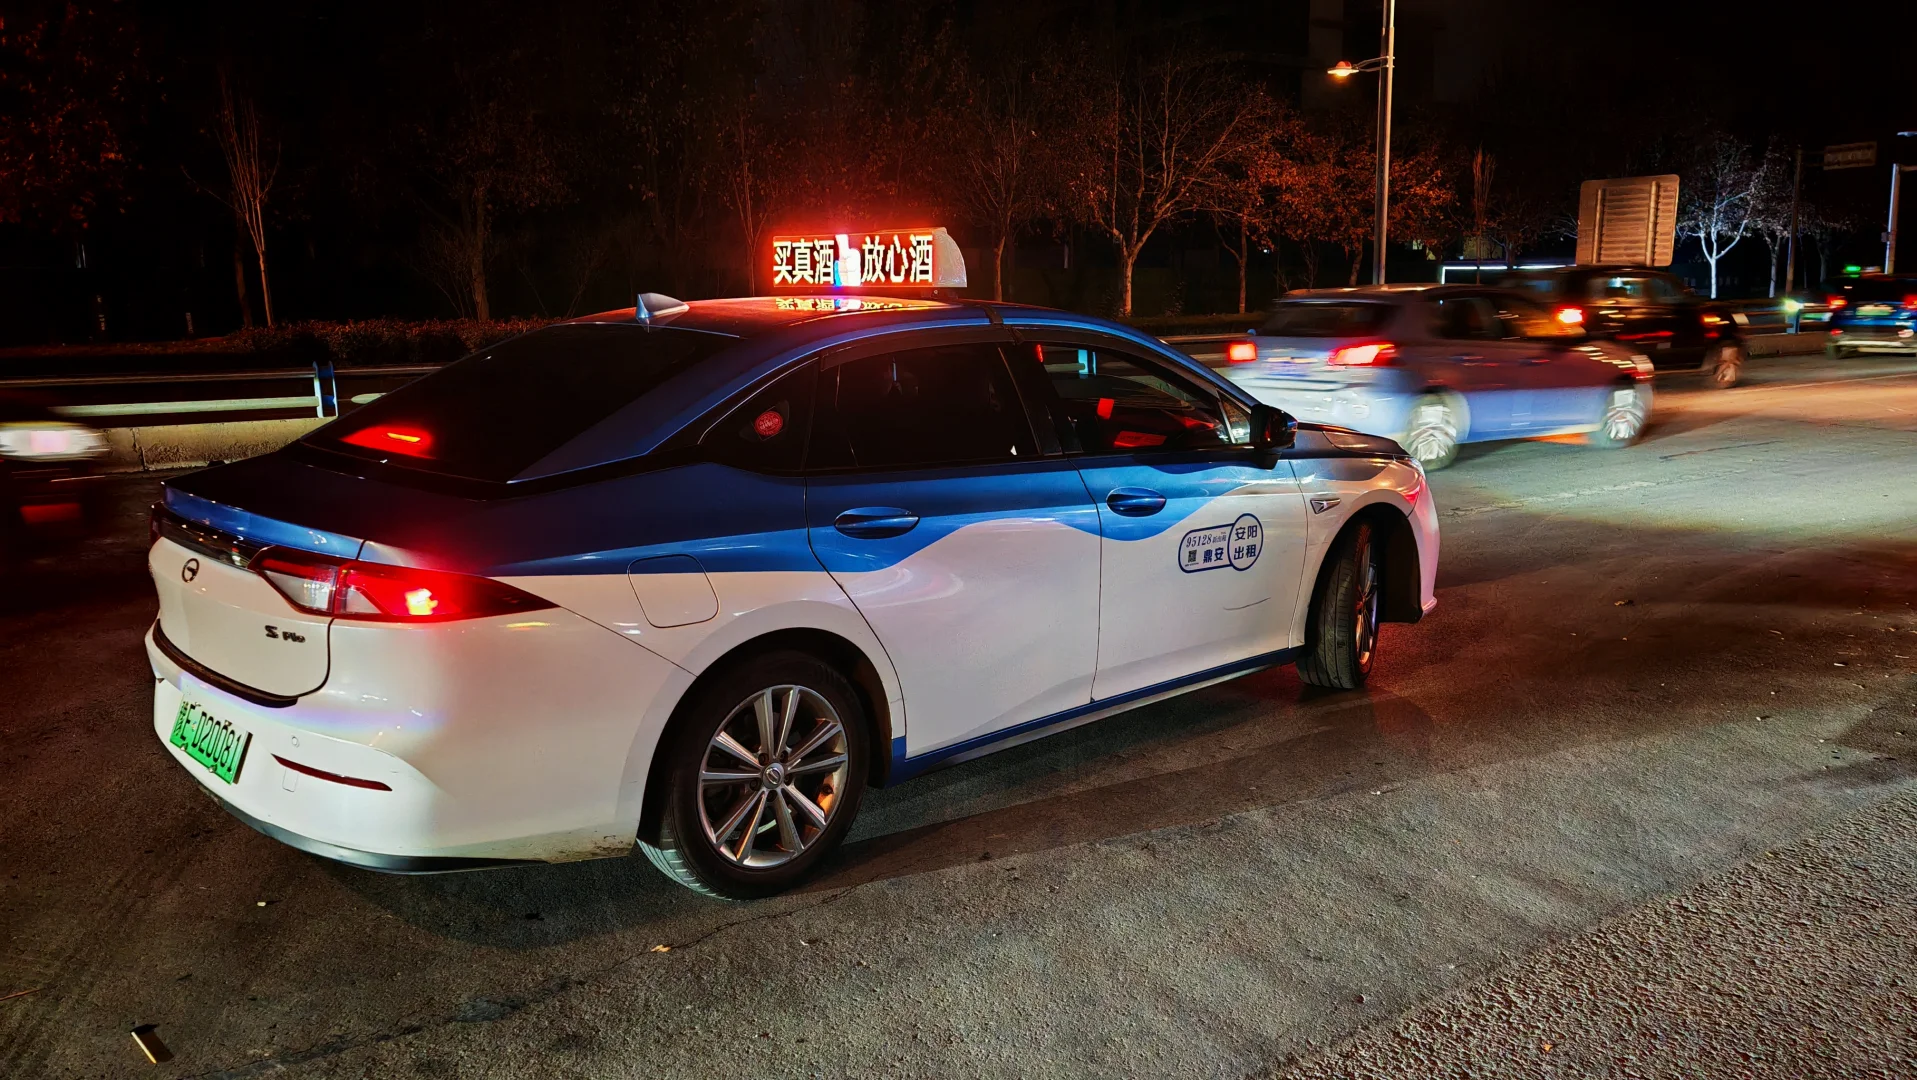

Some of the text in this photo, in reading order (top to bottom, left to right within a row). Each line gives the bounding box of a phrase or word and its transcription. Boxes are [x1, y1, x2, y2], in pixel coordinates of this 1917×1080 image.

[773, 234, 933, 285] 买真酒 放心酒
[1185, 534, 1213, 548] 95128
[1234, 525, 1258, 542] 安阳
[1202, 547, 1224, 564] 鼎安
[1233, 544, 1257, 560] 出租
